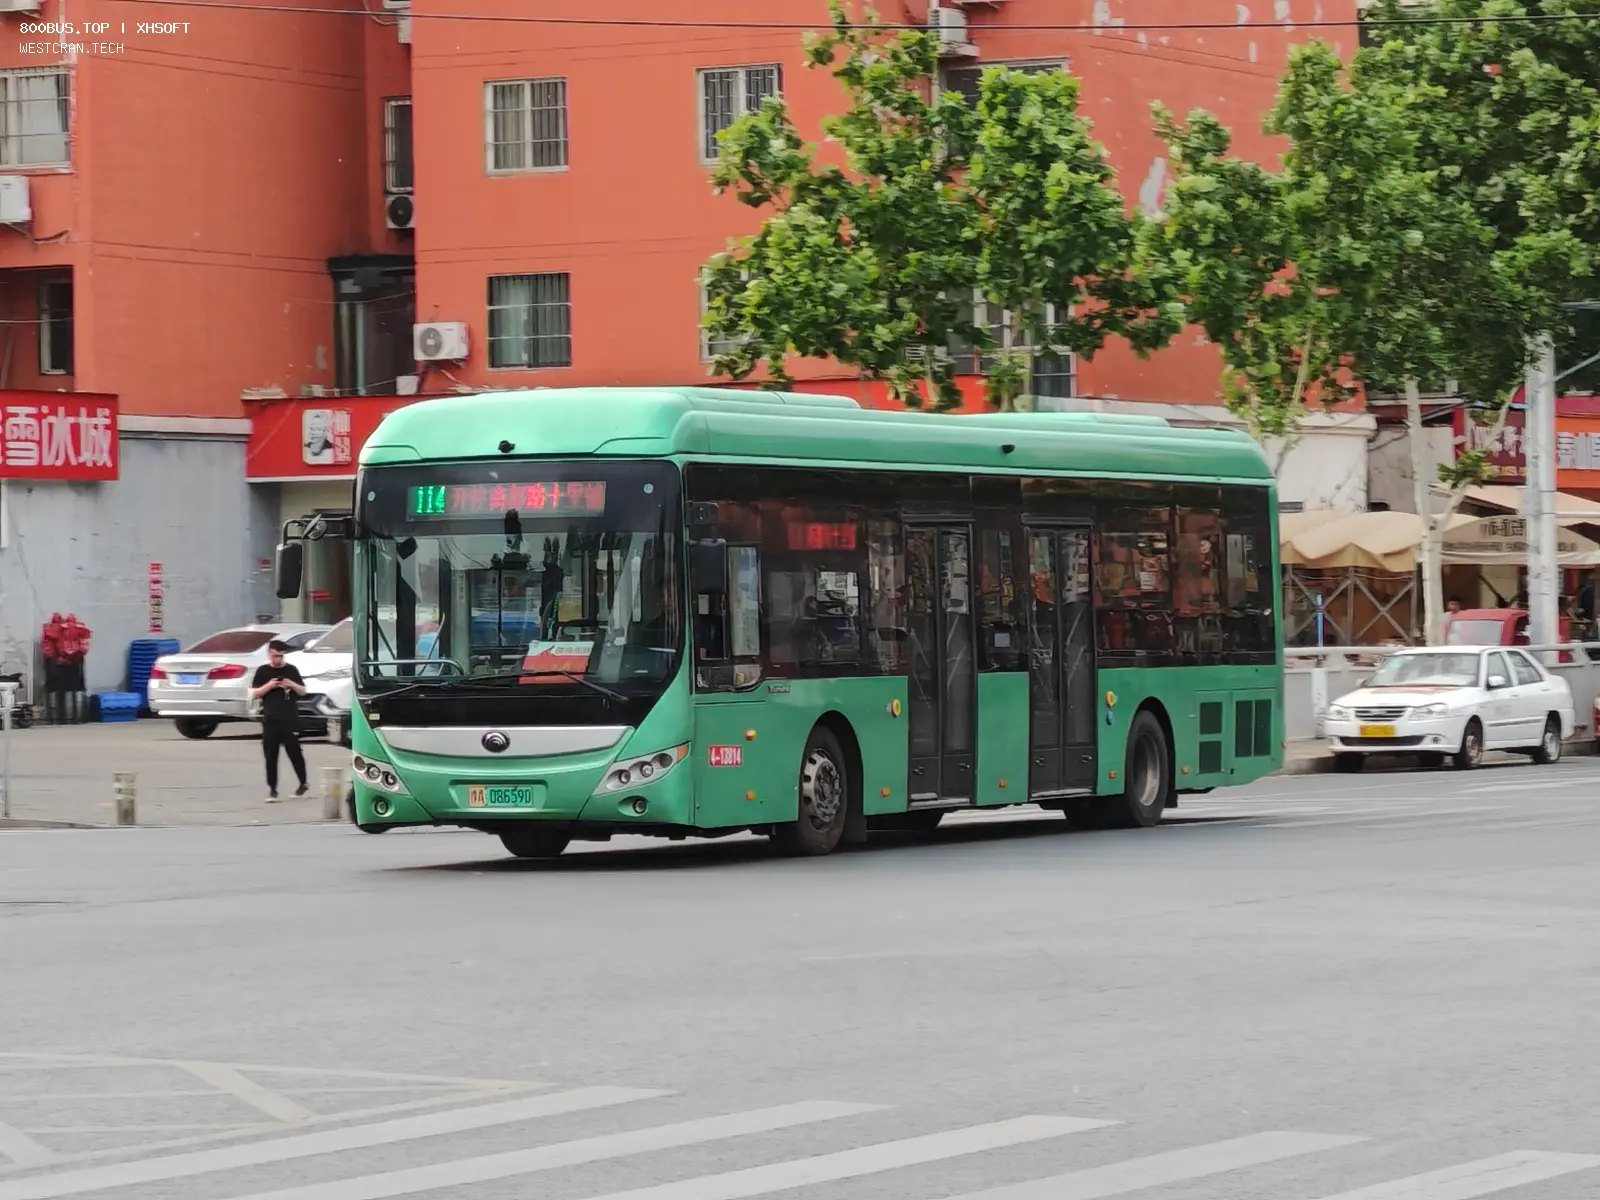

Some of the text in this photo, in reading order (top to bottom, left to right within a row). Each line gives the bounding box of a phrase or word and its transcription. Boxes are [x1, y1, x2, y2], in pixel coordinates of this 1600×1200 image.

[0, 406, 113, 467] 雪冰城
[415, 485, 446, 513] 114
